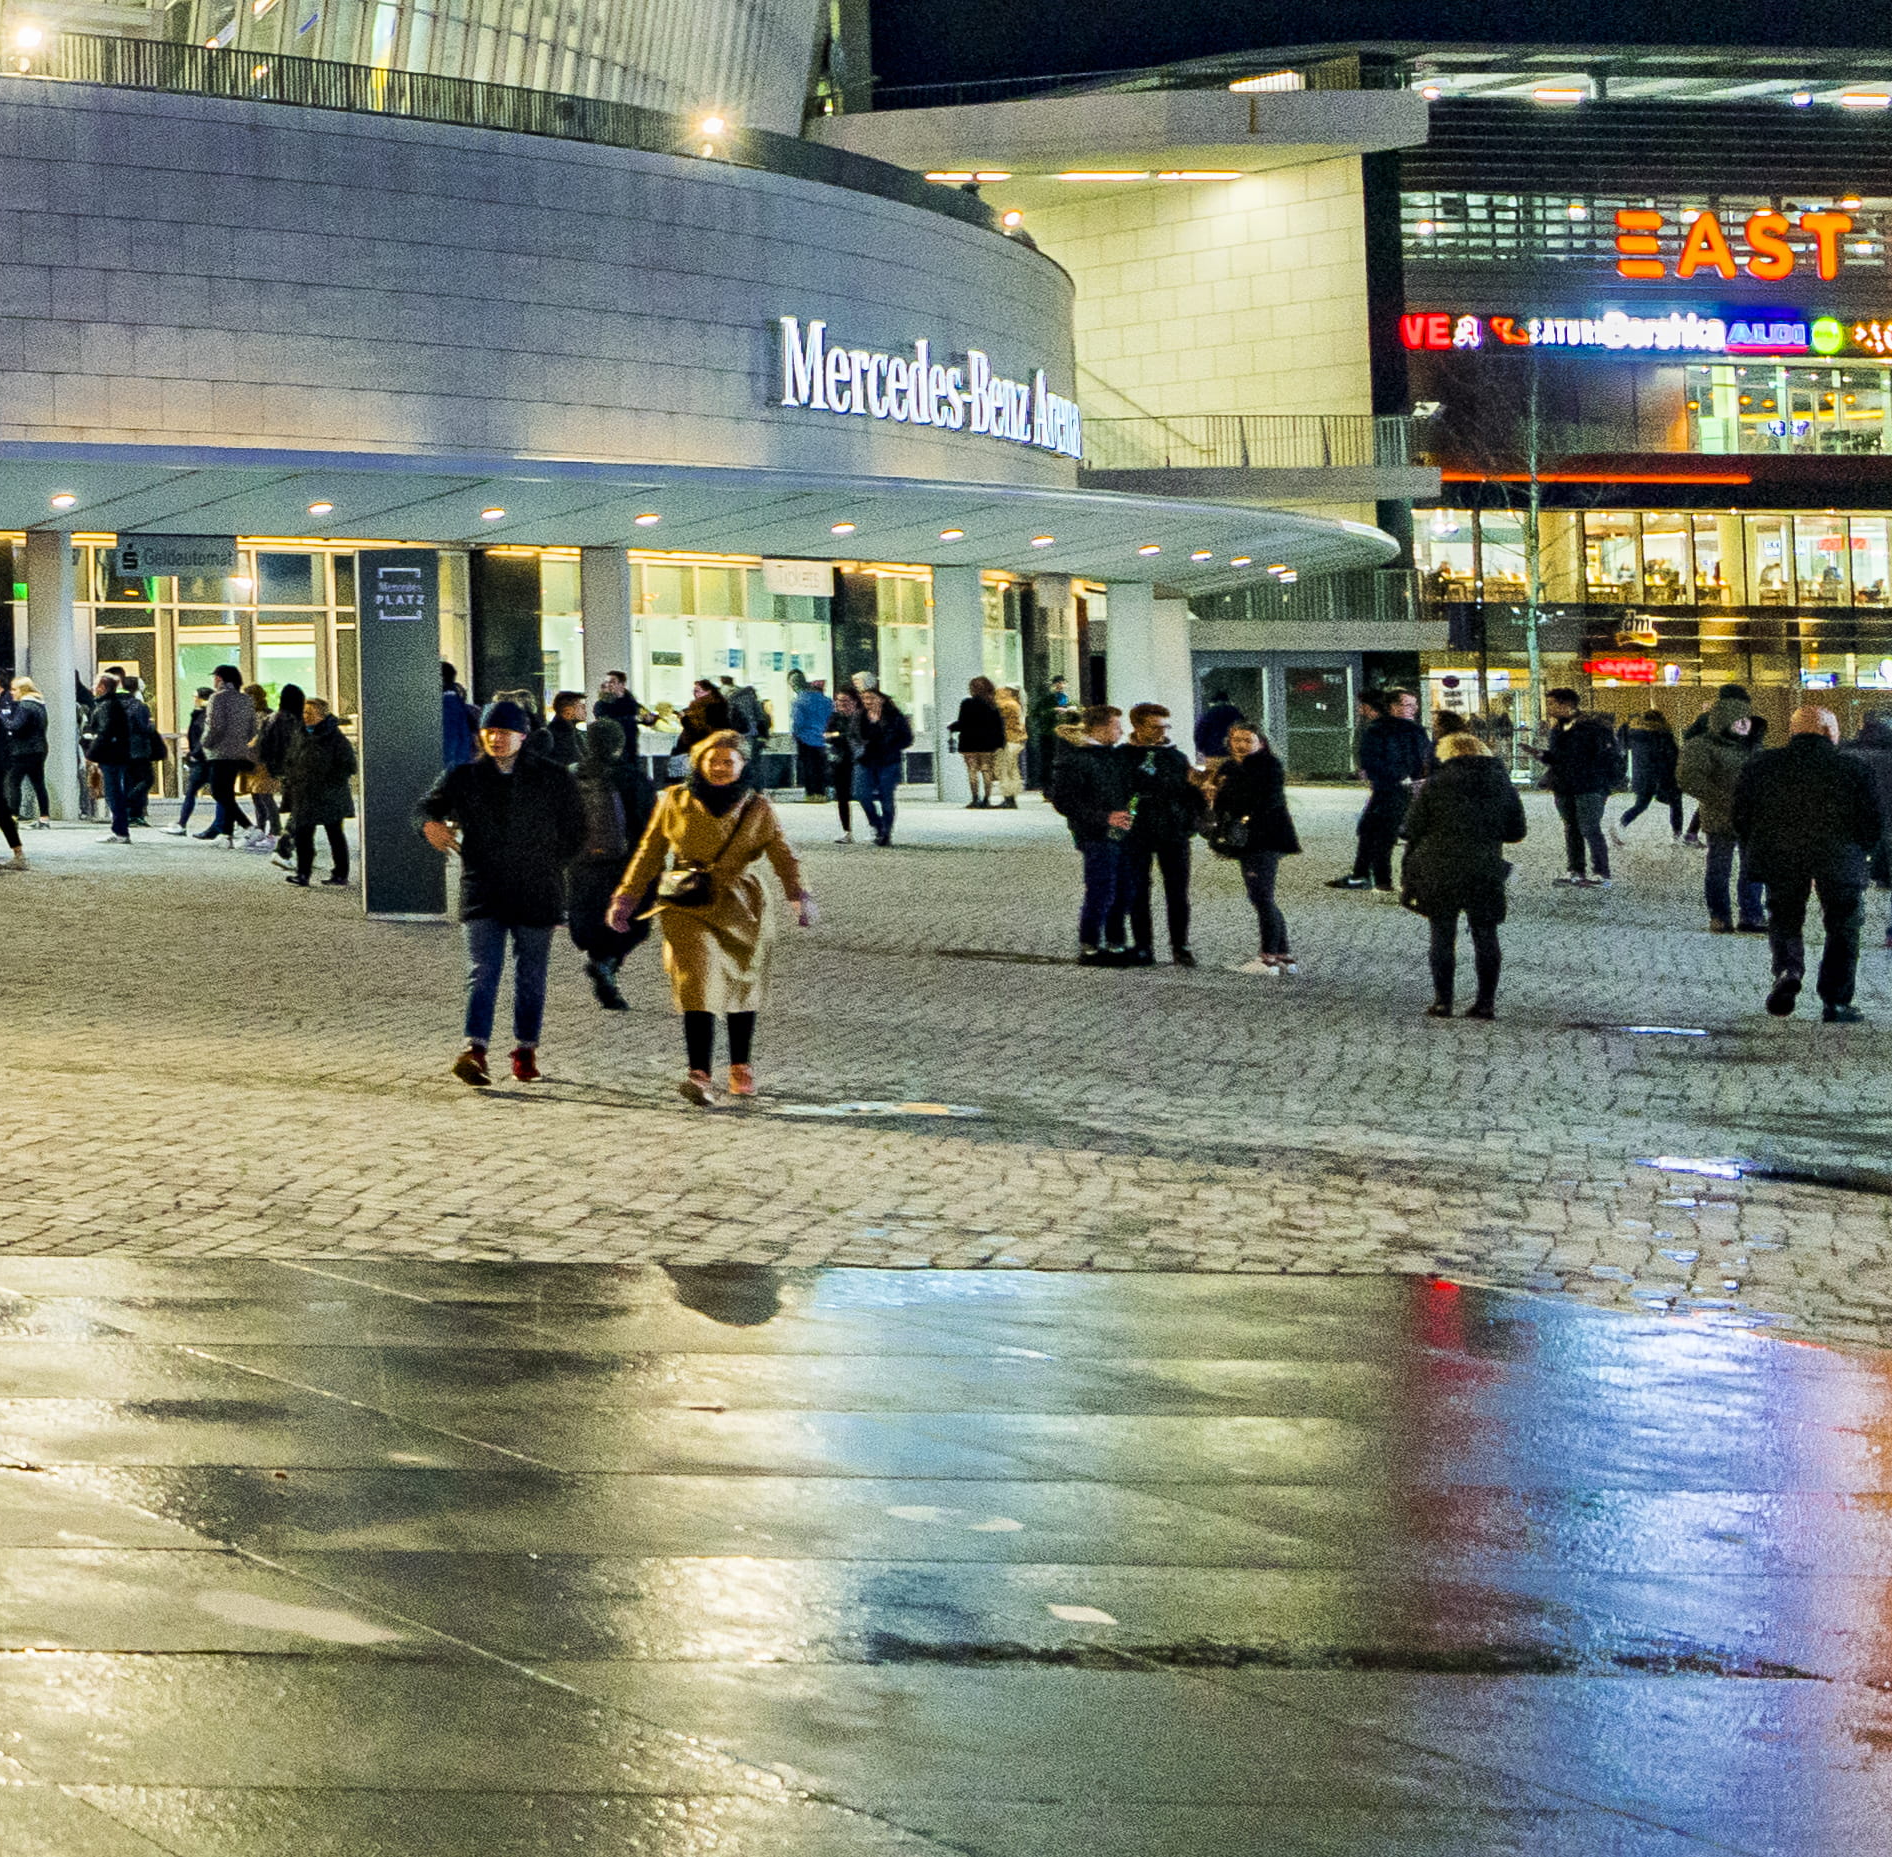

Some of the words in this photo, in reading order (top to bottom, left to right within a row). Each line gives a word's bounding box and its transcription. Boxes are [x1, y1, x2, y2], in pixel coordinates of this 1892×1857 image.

[1615, 210, 1852, 281] EAST
[780, 316, 1031, 443] Mercedes-Benz
[144, 547, 233, 566] Geldautomat
[376, 594, 425, 605] PLATZ
[1625, 609, 1654, 633] dm
